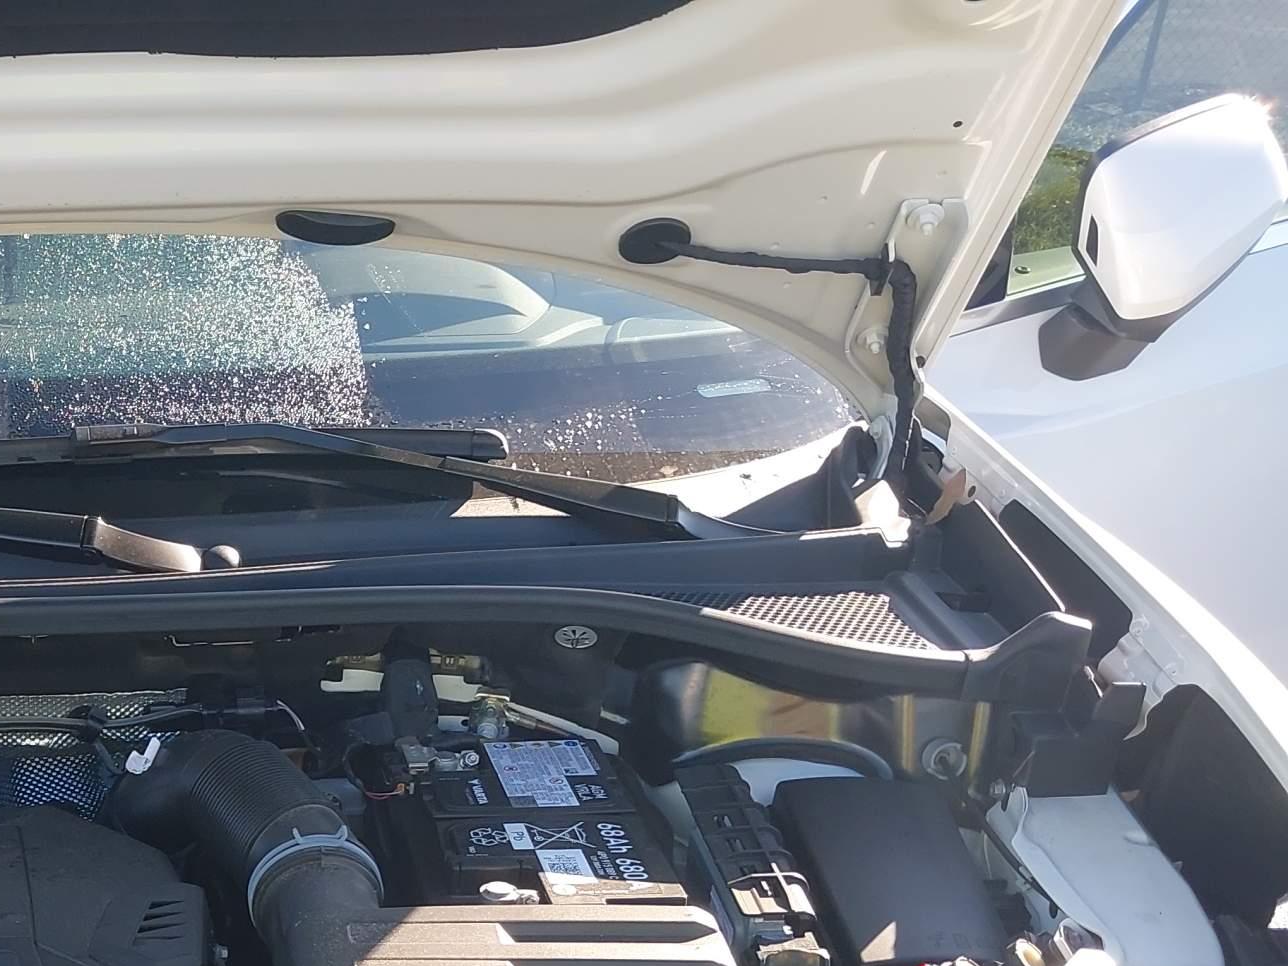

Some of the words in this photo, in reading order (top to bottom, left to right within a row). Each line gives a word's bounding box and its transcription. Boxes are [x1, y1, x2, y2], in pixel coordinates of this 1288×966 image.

[472, 784, 489, 805] VARTA
[574, 783, 593, 801] VRLA
[587, 784, 609, 799] AGM
[510, 831, 526, 841] Pb
[597, 823, 633, 853] 68Ah
